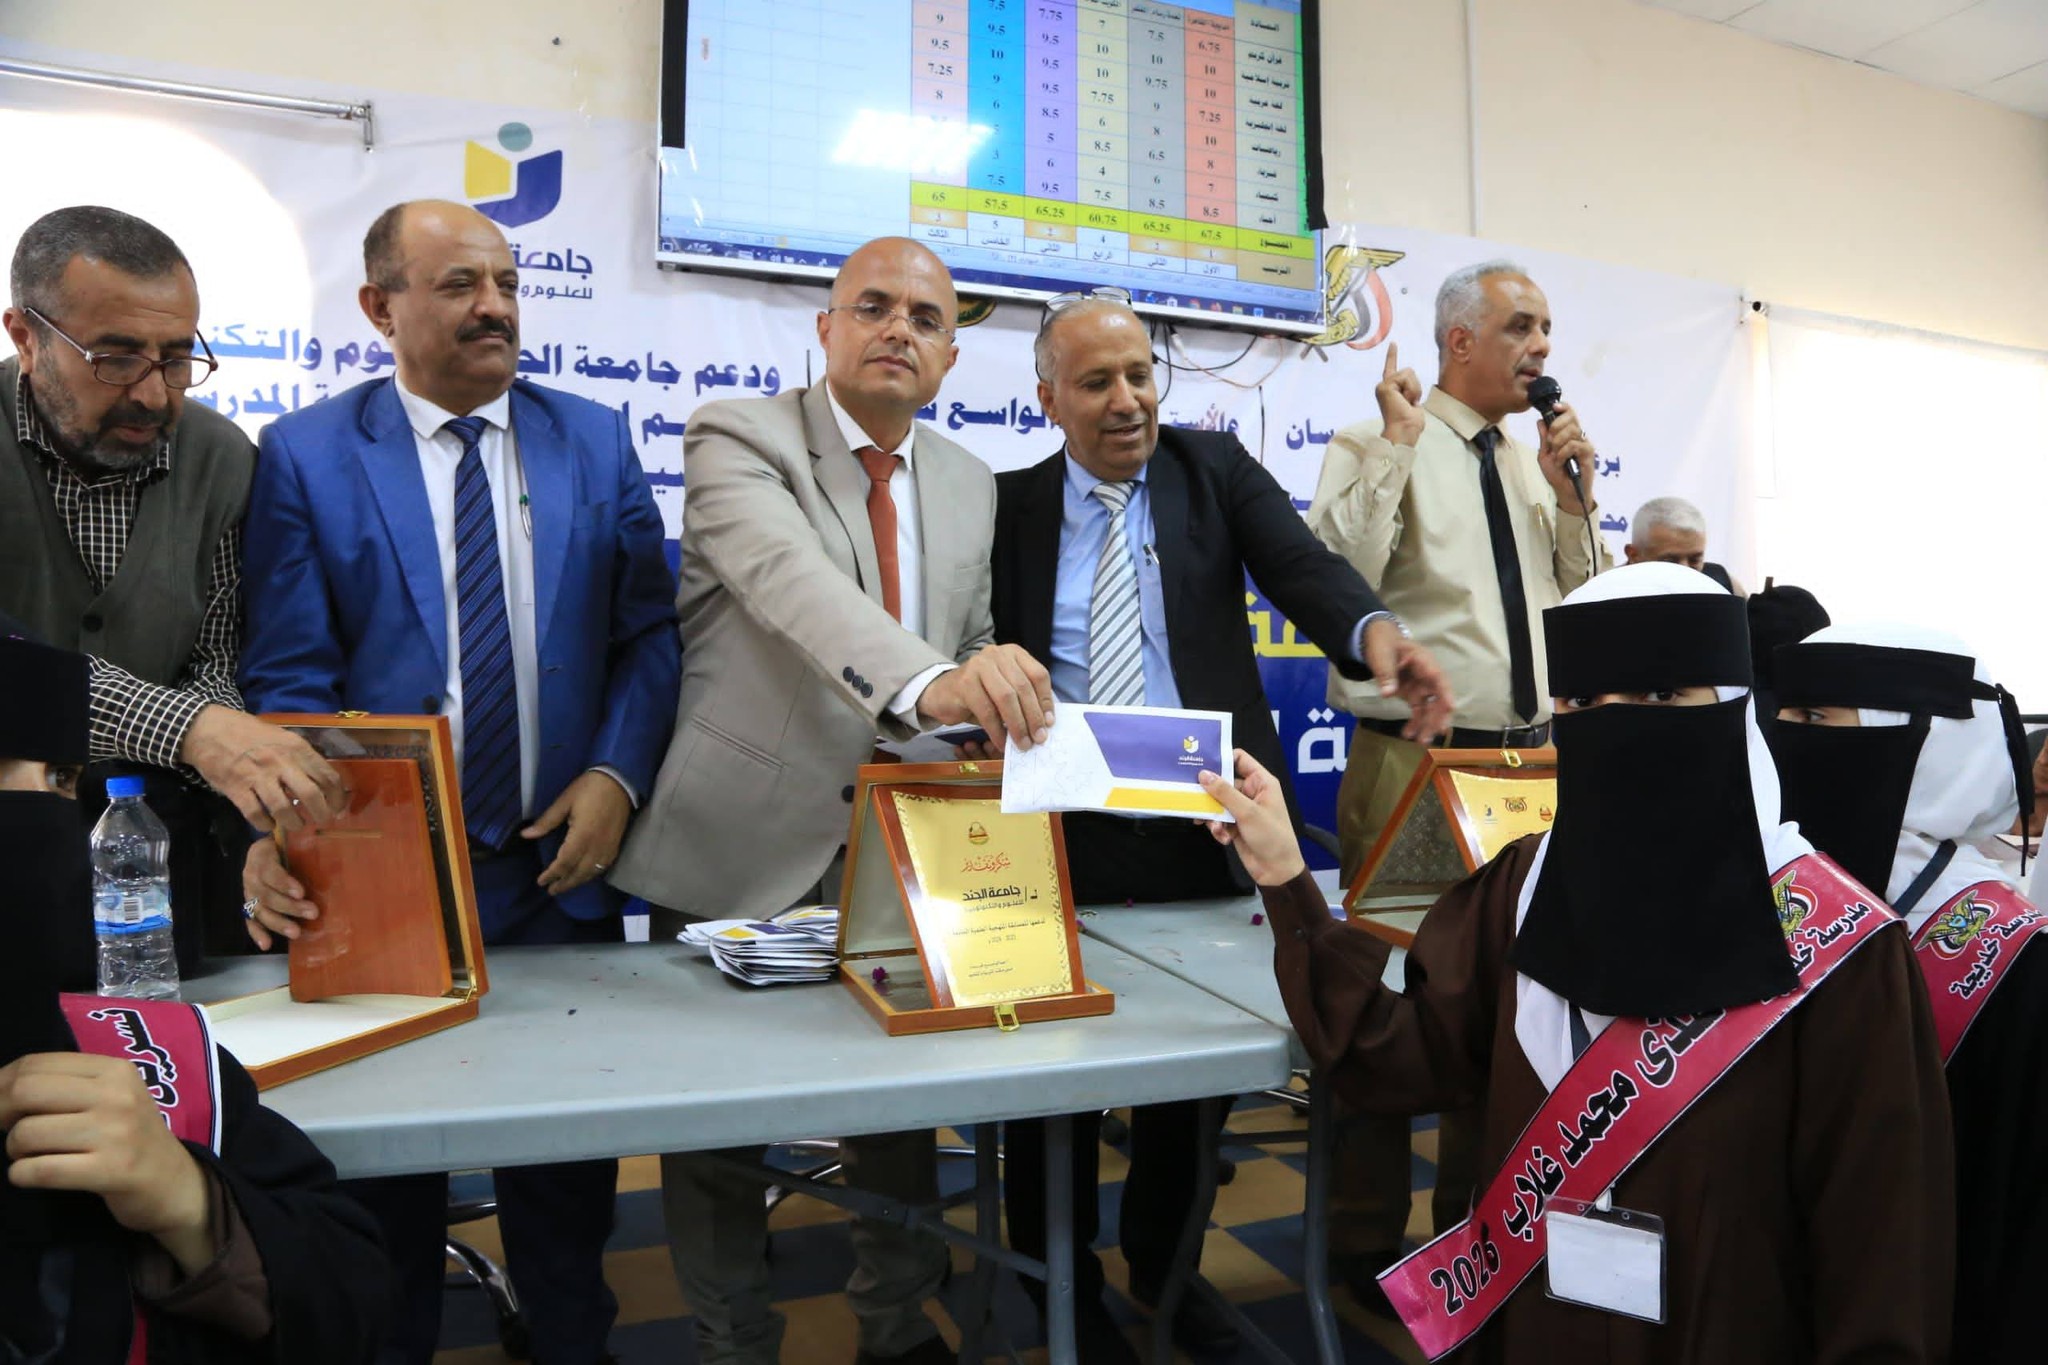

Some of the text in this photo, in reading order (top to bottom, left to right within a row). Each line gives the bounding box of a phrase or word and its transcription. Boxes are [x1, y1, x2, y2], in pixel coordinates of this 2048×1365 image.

[1038, 8, 1063, 21] 7.75
[1099, 19, 1106, 29] 7
[1147, 29, 1165, 42] 7.5
[936, 13, 1216, 76] 10 10 10 9.5 9.5 9
[1198, 41, 1221, 54] 6.75
[931, 38, 1216, 99] 10 9.75 10 9.5 10 9.5
[927, 62, 1221, 123] 7.25 9 7.75 9.5 9 7.25
[993, 100, 1000, 109] 6
[1042, 107, 1060, 119] 8.5
[1099, 117, 1106, 127] 6
[1153, 126, 1160, 136] 8
[1047, 132, 1054, 143] 5
[1204, 135, 1217, 146] 10
[1094, 140, 1111, 152] 8.5
[1148, 150, 1165, 161] 6.5
[1047, 158, 1054, 168] 6
[1207, 159, 1214, 169] 8
[1099, 165, 1106, 176] 4
[1153, 174, 1160, 184] 6
[1208, 182, 1214, 192] 7
[987, 174, 1219, 218] 8.5 8.5 7.5 9.5 7.5
[931, 191, 1222, 241] 67.5 65.25 60.75 65.25 57.5 65
[992, 220, 999, 230] 5
[1100, 234, 1106, 243] 4
[574, 344, 682, 392] جامعة
[694, 363, 781, 398] ودعم
[962, 888, 988, 902] الجند
[988, 884, 1022, 898] جامعة
[1806, 902, 1872, 949] مدرسة
[1949, 938, 2001, 1000] خديجة
[1558, 1070, 1639, 1167] محمد
[1503, 1145, 1566, 1242] غلاب
